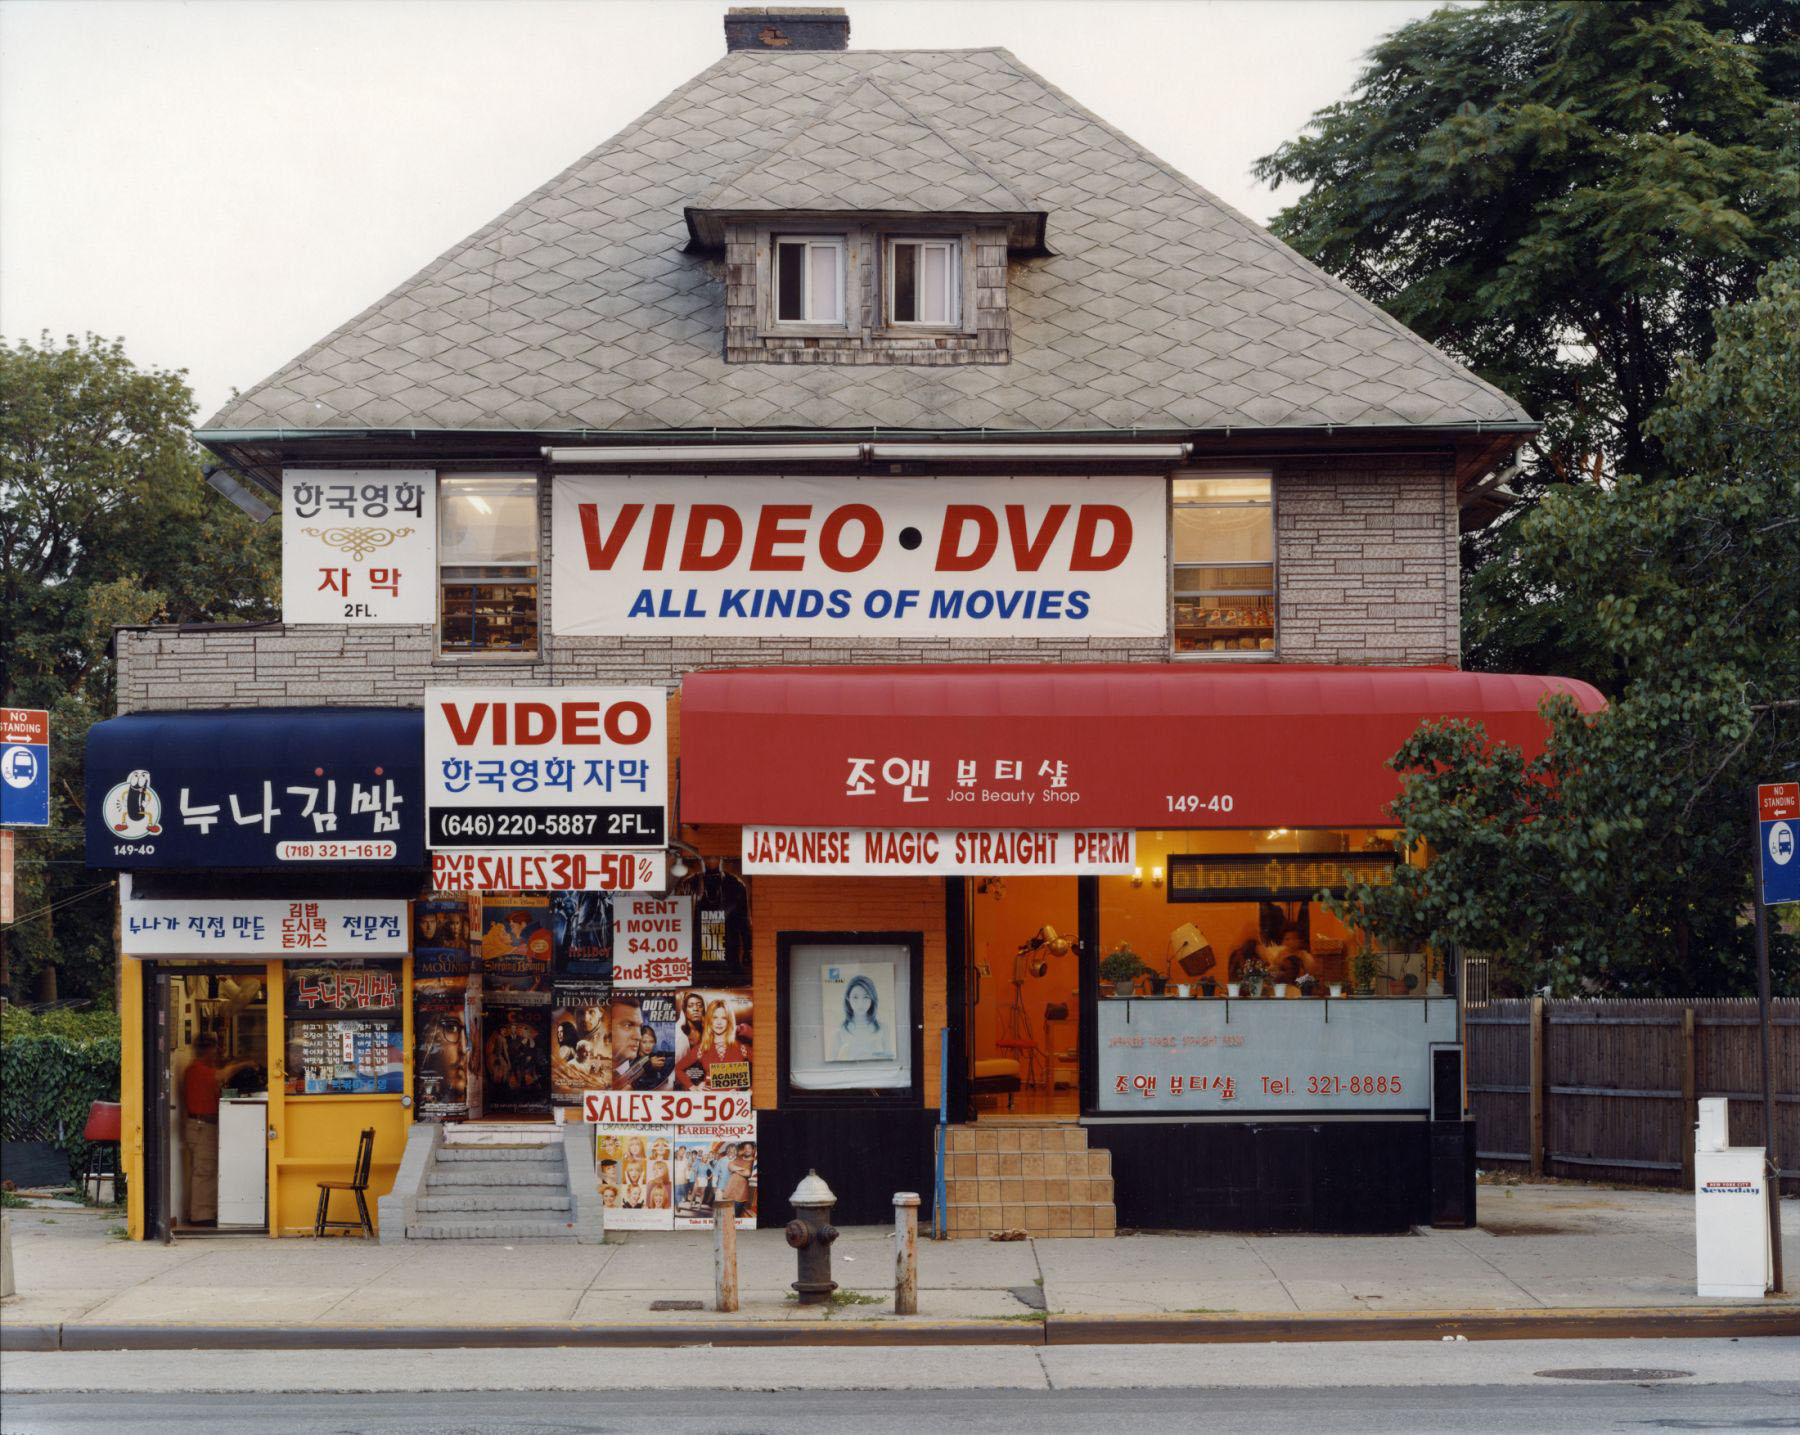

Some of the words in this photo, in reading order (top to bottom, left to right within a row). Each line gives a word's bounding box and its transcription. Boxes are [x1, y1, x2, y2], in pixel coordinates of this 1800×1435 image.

[293, 482, 425, 518] 한국영화
[578, 503, 884, 573] VIDEO
[935, 503, 1133, 573] DVD
[344, 603, 377, 618] 2FL.
[628, 590, 706, 619] ALL
[726, 590, 851, 619] KINDS
[864, 589, 919, 620] OF
[929, 589, 1091, 620] MOVIES
[10, 711, 28, 722] NO
[441, 701, 652, 746] VIDEO
[846, 757, 931, 803] 조앤
[946, 789, 978, 802] Joa
[982, 789, 1036, 804] Beauty
[1042, 789, 1080, 804] Shop
[1773, 786, 1784, 796] NO
[1166, 795, 1234, 812] 149-40
[1764, 796, 1796, 808] STANDING
[608, 814, 656, 835] 2FL.
[113, 845, 155, 856] 149-40
[285, 845, 314, 858] (718)
[319, 845, 393, 857] 321-1612
[747, 832, 850, 864] JAPANESE
[865, 831, 939, 864] MAGIC
[955, 832, 1059, 864] STRAIGHT
[1074, 832, 1129, 864] PERM
[432, 854, 474, 871] DVD
[432, 871, 474, 890] VHS
[477, 856, 548, 890] SALES
[289, 903, 319, 917] 김밥
[633, 901, 679, 915] RENT
[701, 911, 725, 920] DMX
[129, 917, 180, 935] 누나가
[188, 917, 226, 939] 직접
[233, 917, 265, 941] 만든
[281, 918, 327, 934] 도시락
[342, 916, 401, 941] 전문점
[613, 921, 621, 932] 1
[627, 920, 682, 932] MOVIE
[701, 923, 725, 934] NEVER
[281, 933, 327, 949] 돈까스
[628, 938, 678, 954] $4.00
[701, 934, 725, 950] DIE
[701, 950, 726, 961] ALONE
[613, 965, 642, 980] 2nd
[642, 1000, 662, 1011] OUT
[650, 1011, 676, 1021] REAC
[712, 1072, 748, 1080] AGAINST
[715, 1079, 748, 1088] ROPES
[1115, 1075, 1156, 1097] 조앤
[1261, 1076, 1294, 1094] Tel.
[1307, 1076, 1402, 1094] 321-8885
[586, 1095, 653, 1123] SALES
[748, 1124, 754, 1134] 2
[1701, 1187, 1760, 1195] Newsday
